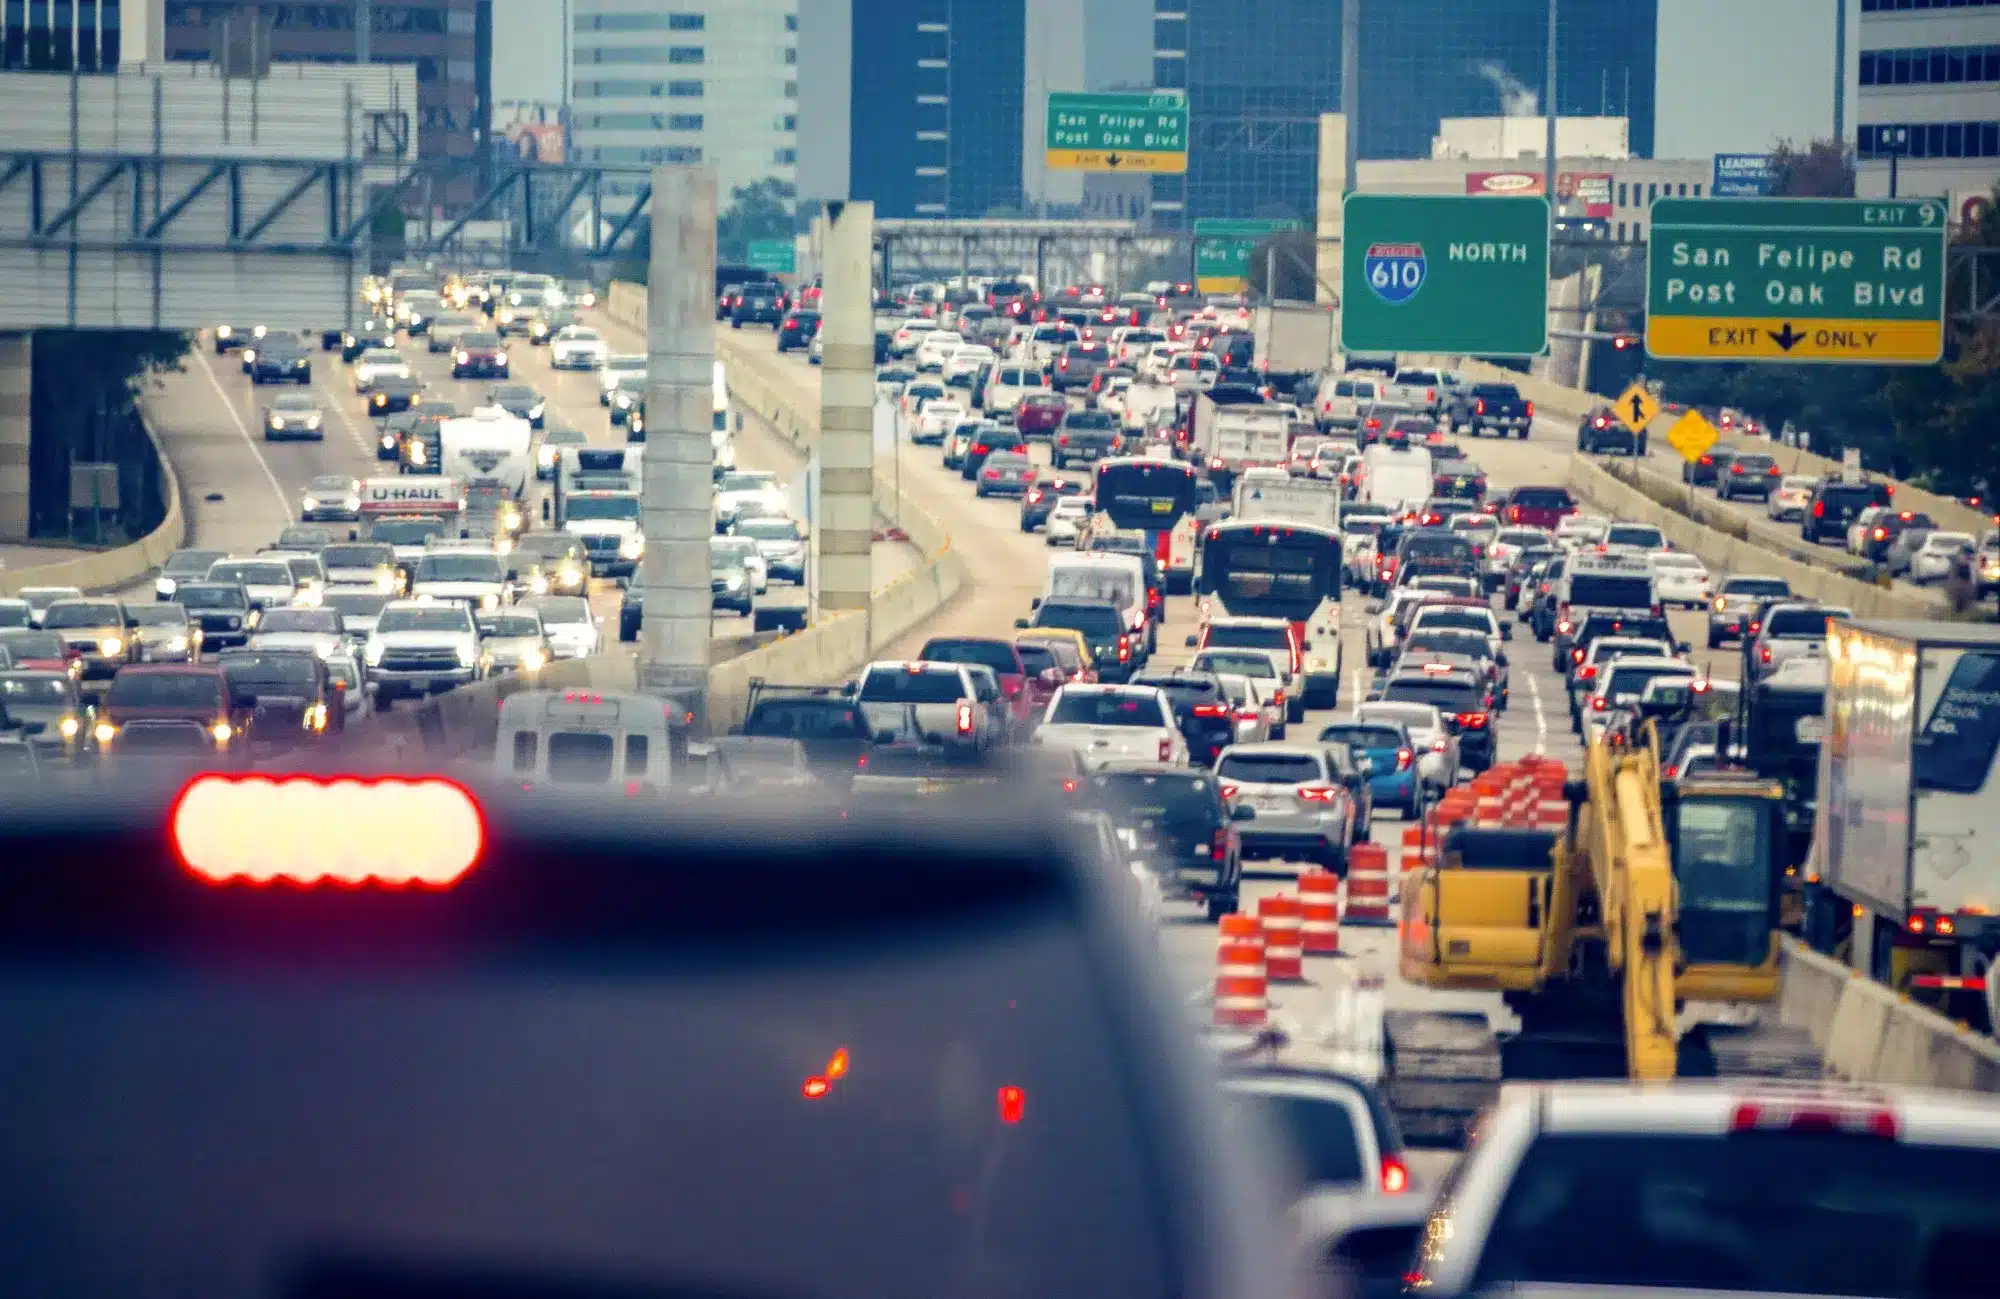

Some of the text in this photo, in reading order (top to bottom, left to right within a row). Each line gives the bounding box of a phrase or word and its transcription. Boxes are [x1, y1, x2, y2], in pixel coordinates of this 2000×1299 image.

[1058, 112, 1178, 130] San Felipe Rd
[1055, 130, 1179, 146] Post Oak Blvd
[1863, 203, 1936, 226] EXIT 9
[1449, 241, 1527, 263] NORTH
[1672, 241, 1922, 273] San Felipe Rd
[1371, 261, 1421, 289] 610
[1667, 278, 1924, 306] Post Oak Blvd
[1708, 327, 1878, 348] EXIT ONLY
